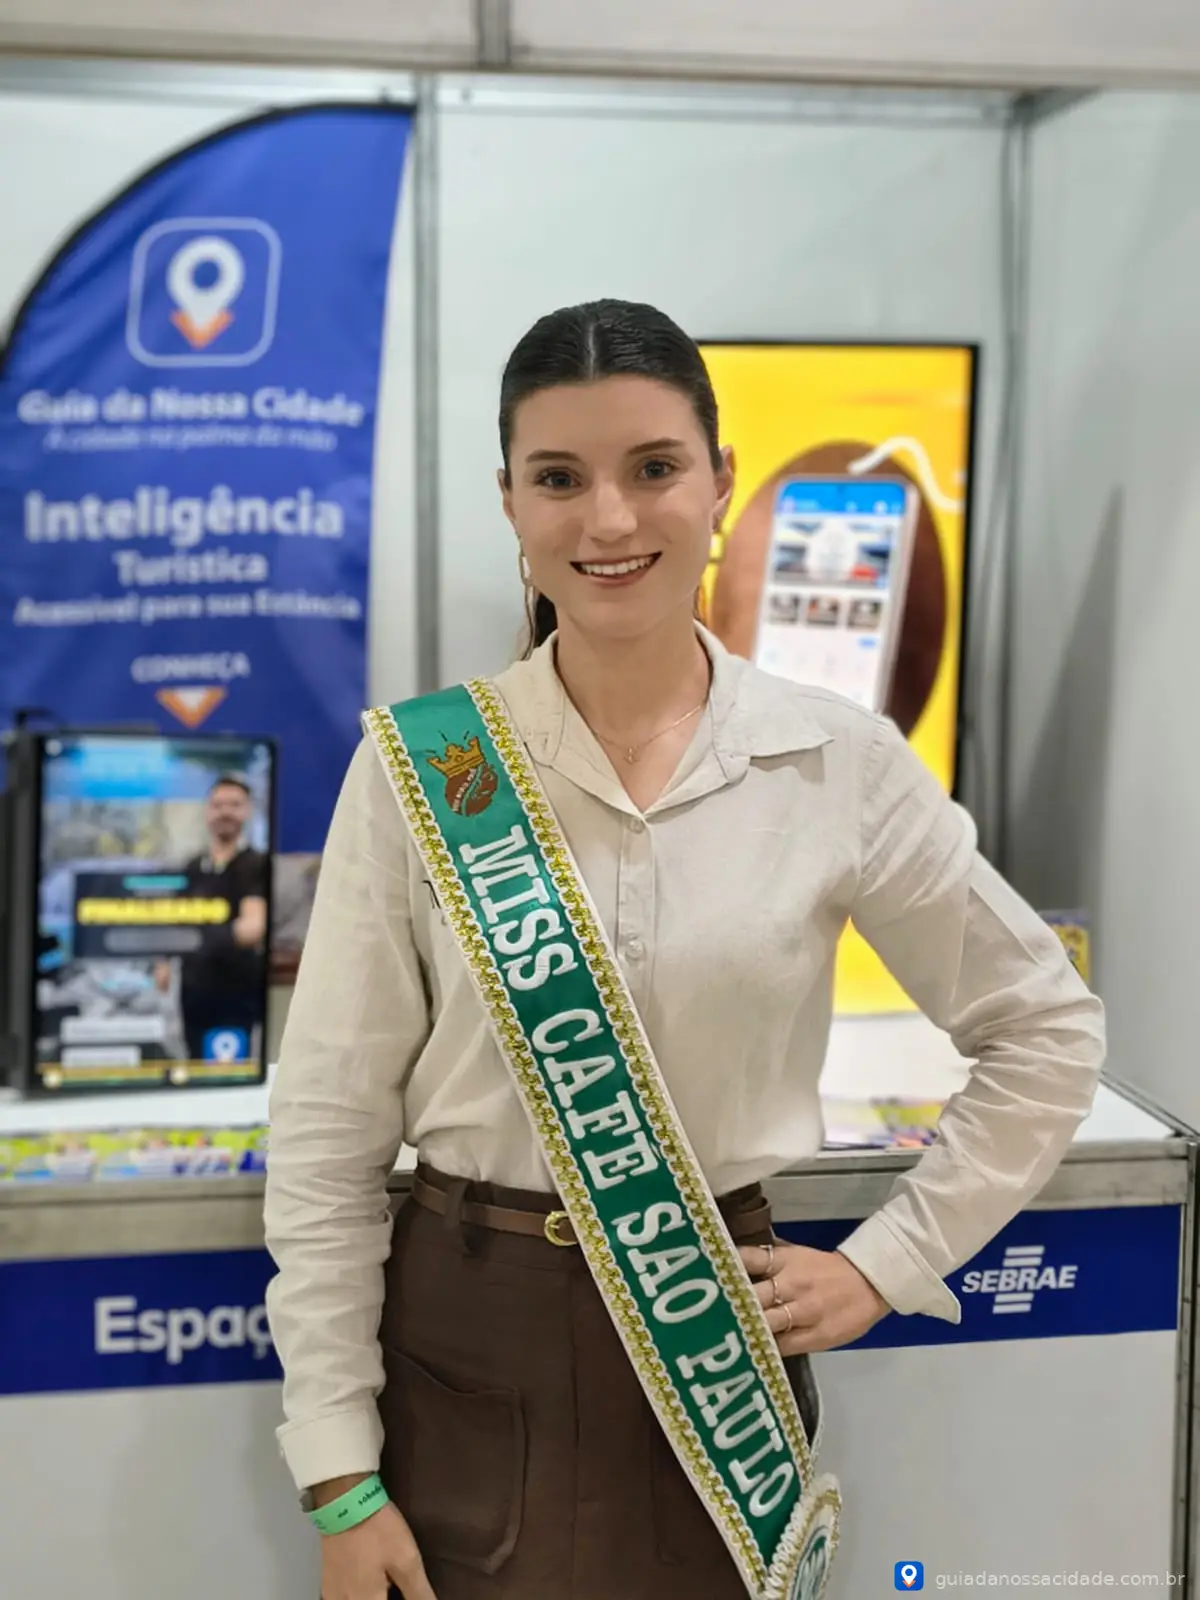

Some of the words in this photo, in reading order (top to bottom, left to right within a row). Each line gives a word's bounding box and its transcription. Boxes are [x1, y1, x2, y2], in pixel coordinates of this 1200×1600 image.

[102, 387, 147, 422] da
[150, 387, 248, 420] Nossa
[252, 386, 364, 427] Cidade
[24, 484, 344, 548] Inteligência
[112, 547, 268, 586] Turística
[457, 824, 579, 992] MISS
[677, 1330, 795, 1519] PAULO
[962, 1266, 1078, 1294] SEBRAE
